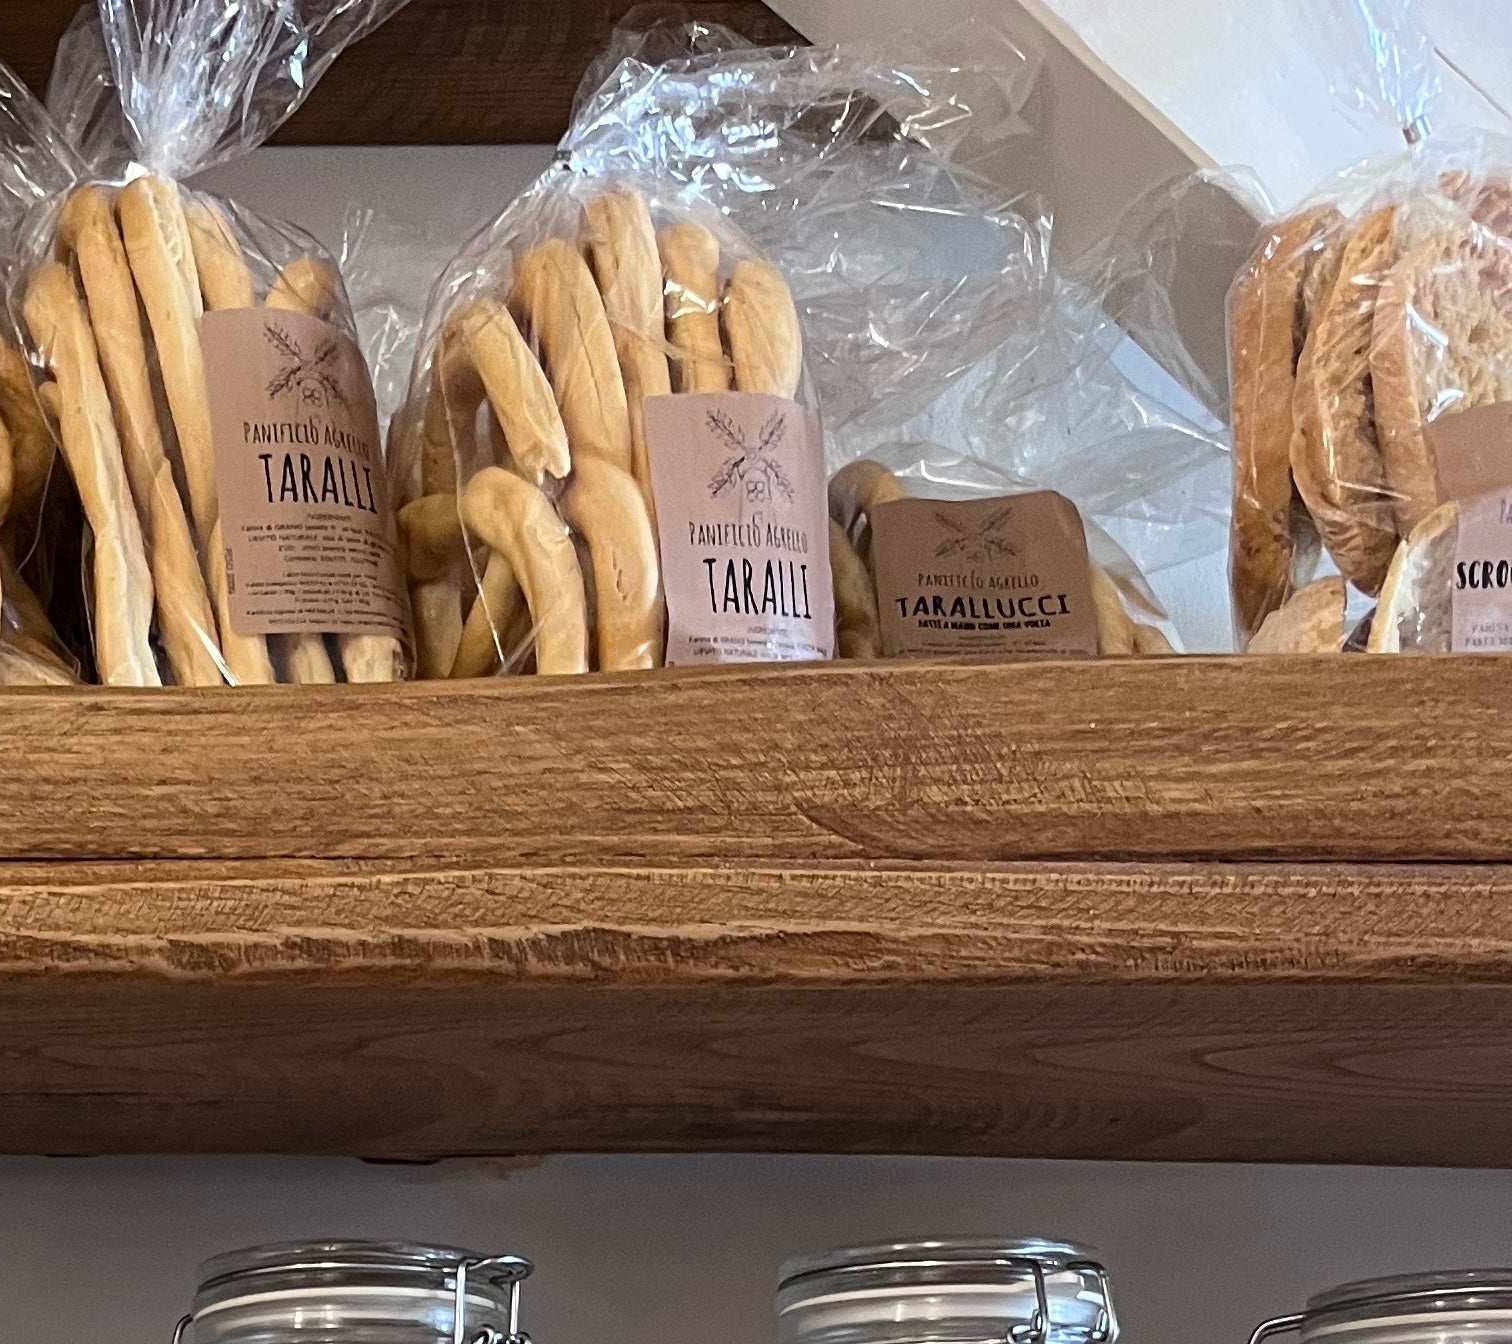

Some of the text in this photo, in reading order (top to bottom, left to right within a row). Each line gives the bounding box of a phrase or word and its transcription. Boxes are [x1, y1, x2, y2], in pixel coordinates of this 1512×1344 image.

[243, 419, 320, 446] PANIFICIO
[258, 452, 378, 514] TARALLI
[688, 519, 809, 555] PANIFICIO AGRELLO
[702, 557, 813, 620] TARALLI
[988, 573, 1040, 591] AGRELLO
[1456, 559, 1512, 590] SCRO
[895, 593, 1071, 619] TARALLUCCI
